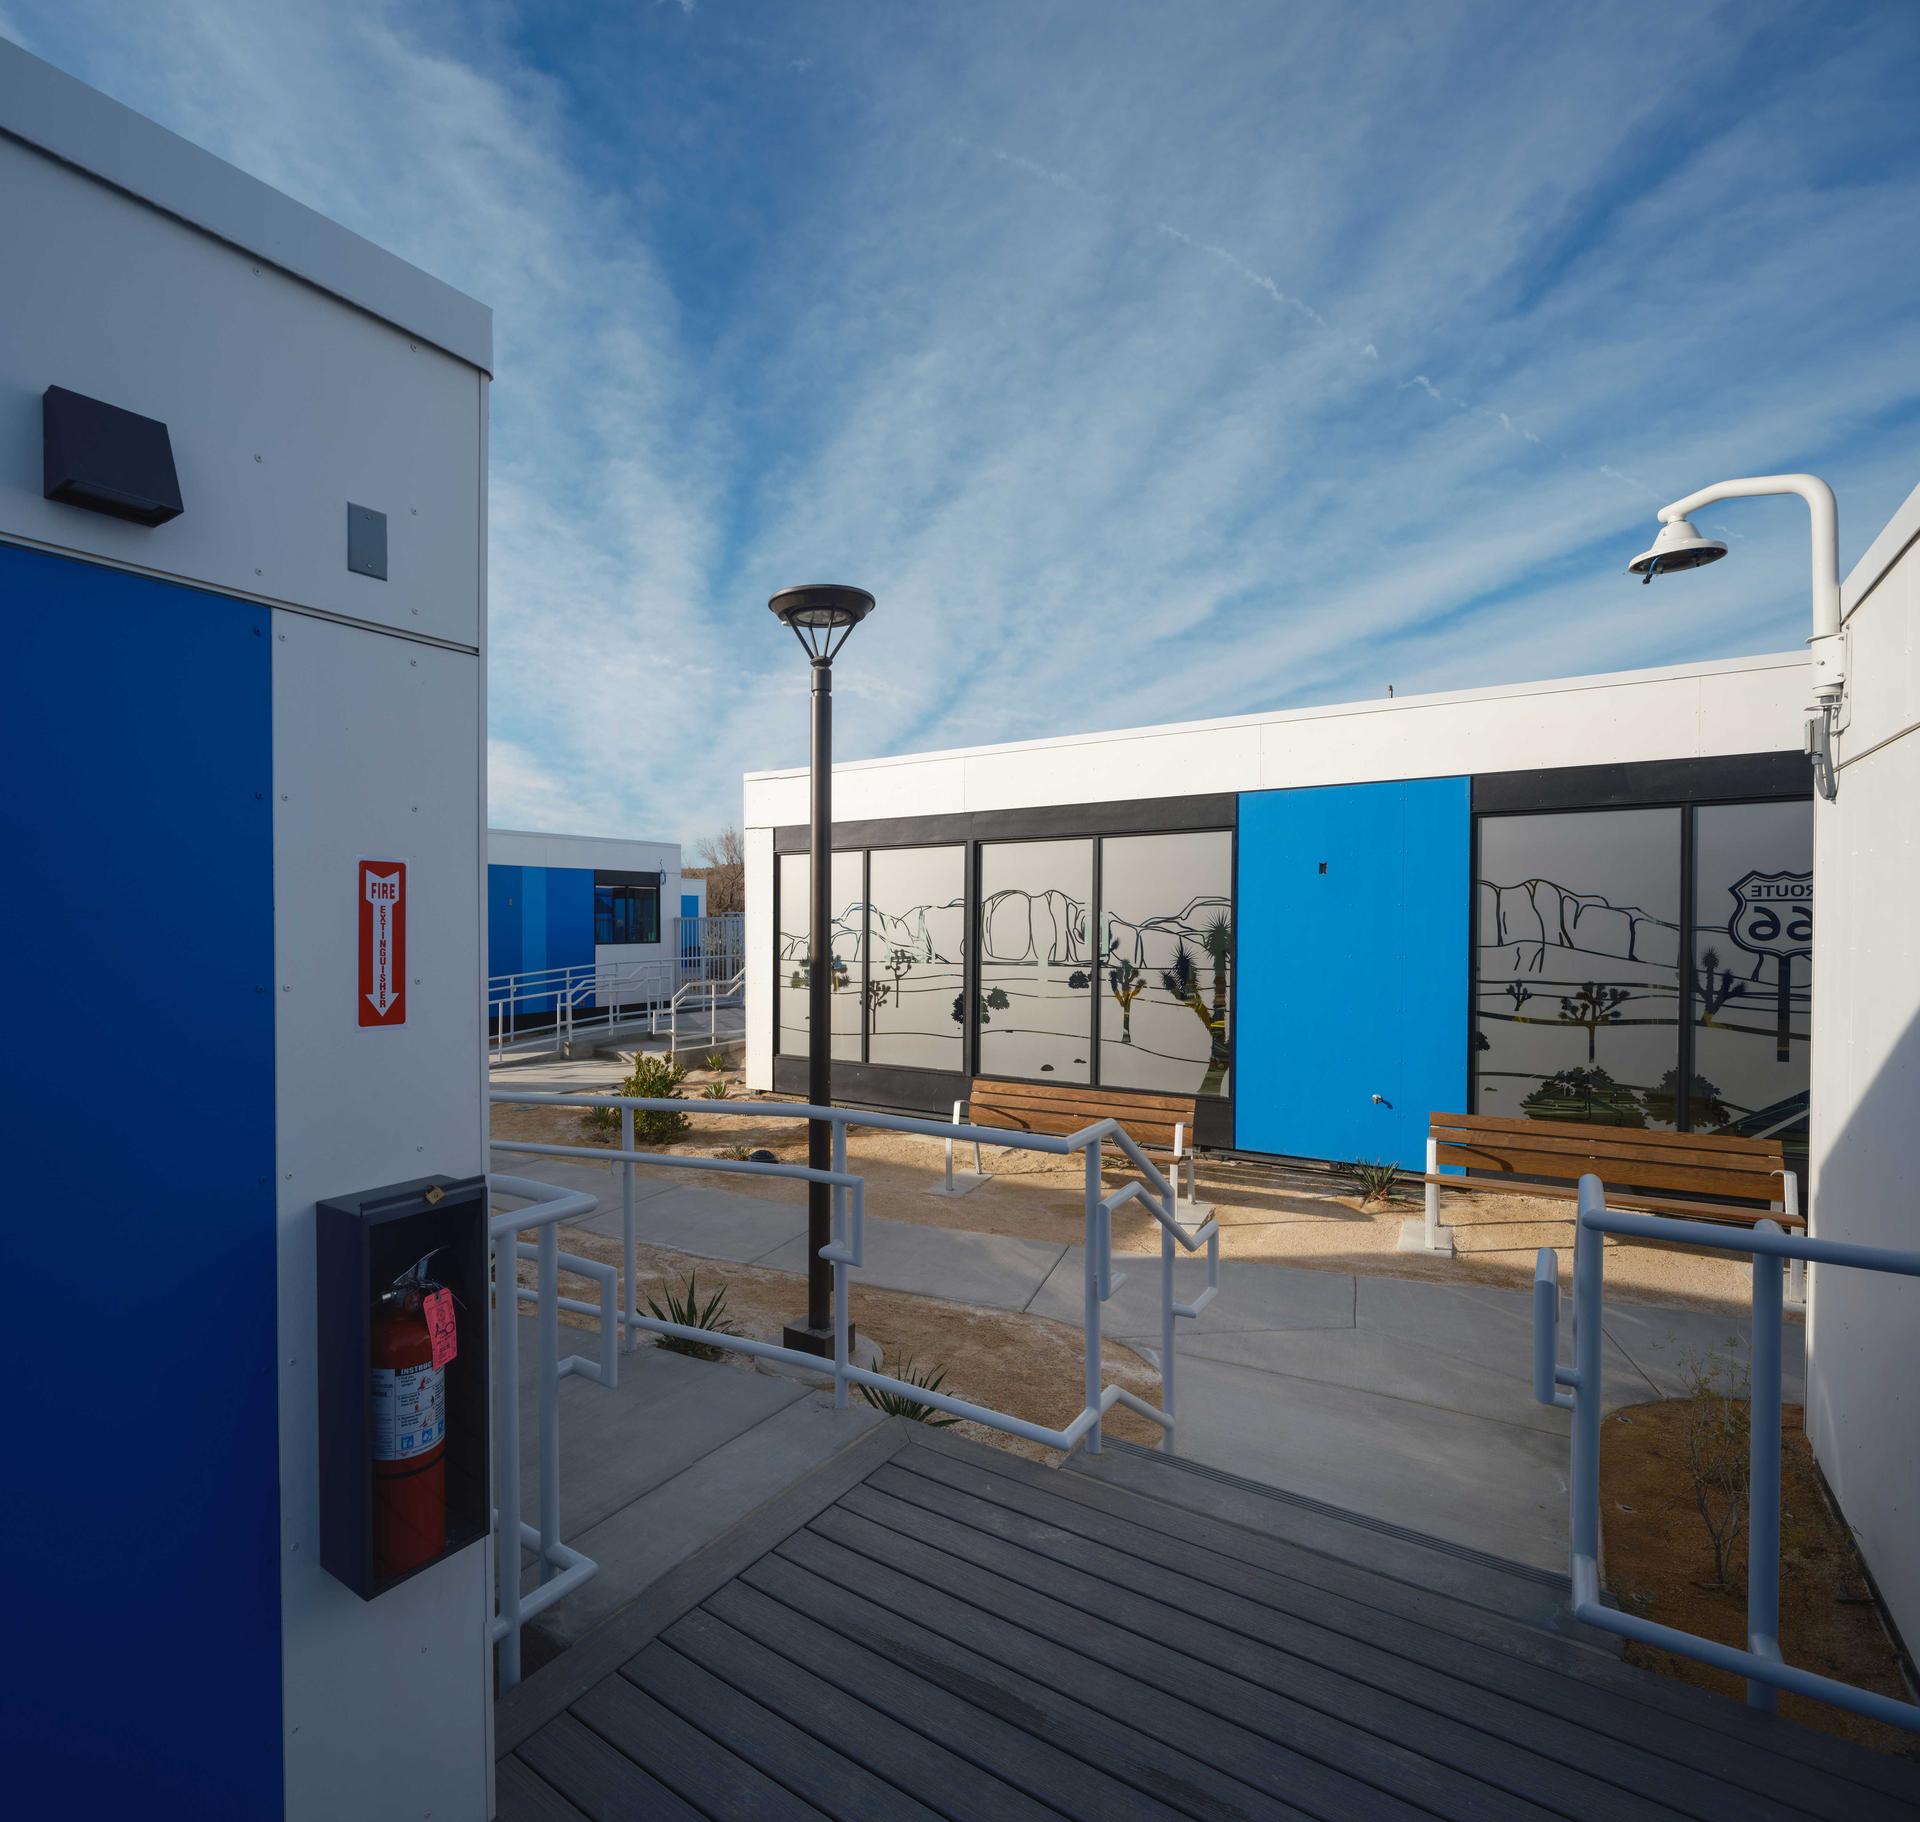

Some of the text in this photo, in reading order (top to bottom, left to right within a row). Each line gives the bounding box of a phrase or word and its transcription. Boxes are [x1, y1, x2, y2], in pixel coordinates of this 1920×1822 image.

[371, 882, 396, 900] FIRE
[379, 905, 387, 1008] EXTINGUISHER
[401, 1361, 432, 1375] INSTRUC
